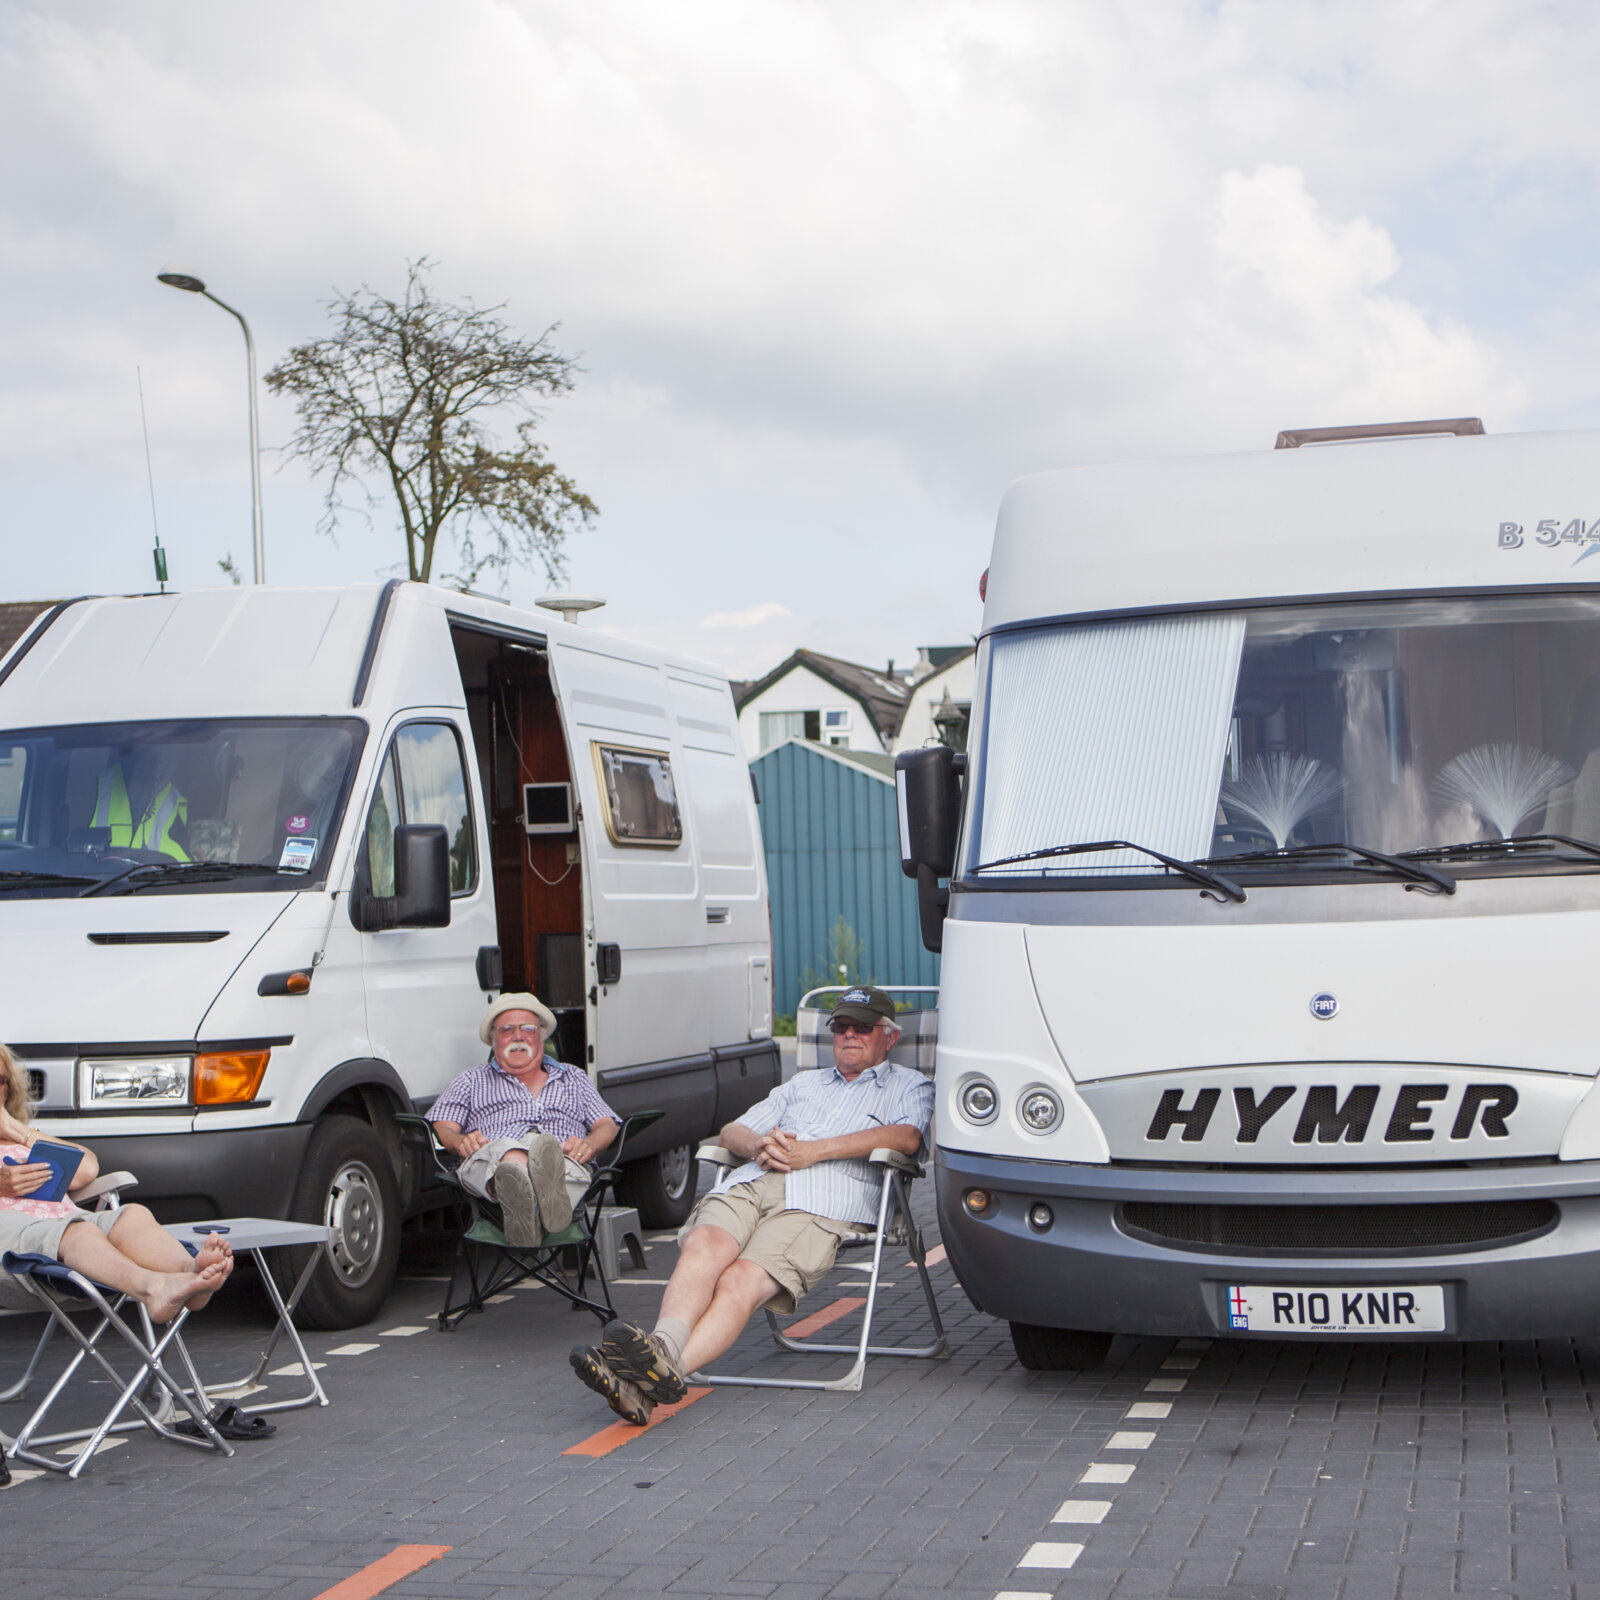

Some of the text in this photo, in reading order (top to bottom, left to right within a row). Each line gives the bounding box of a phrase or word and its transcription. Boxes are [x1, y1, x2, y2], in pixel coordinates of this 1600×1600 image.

[1497, 518, 1600, 550] B 544
[1314, 1000, 1336, 1010] FIAT
[1145, 1084, 1520, 1144] HYMER
[1232, 1316, 1248, 1328] ENG
[1341, 1292, 1416, 1325] KNR
